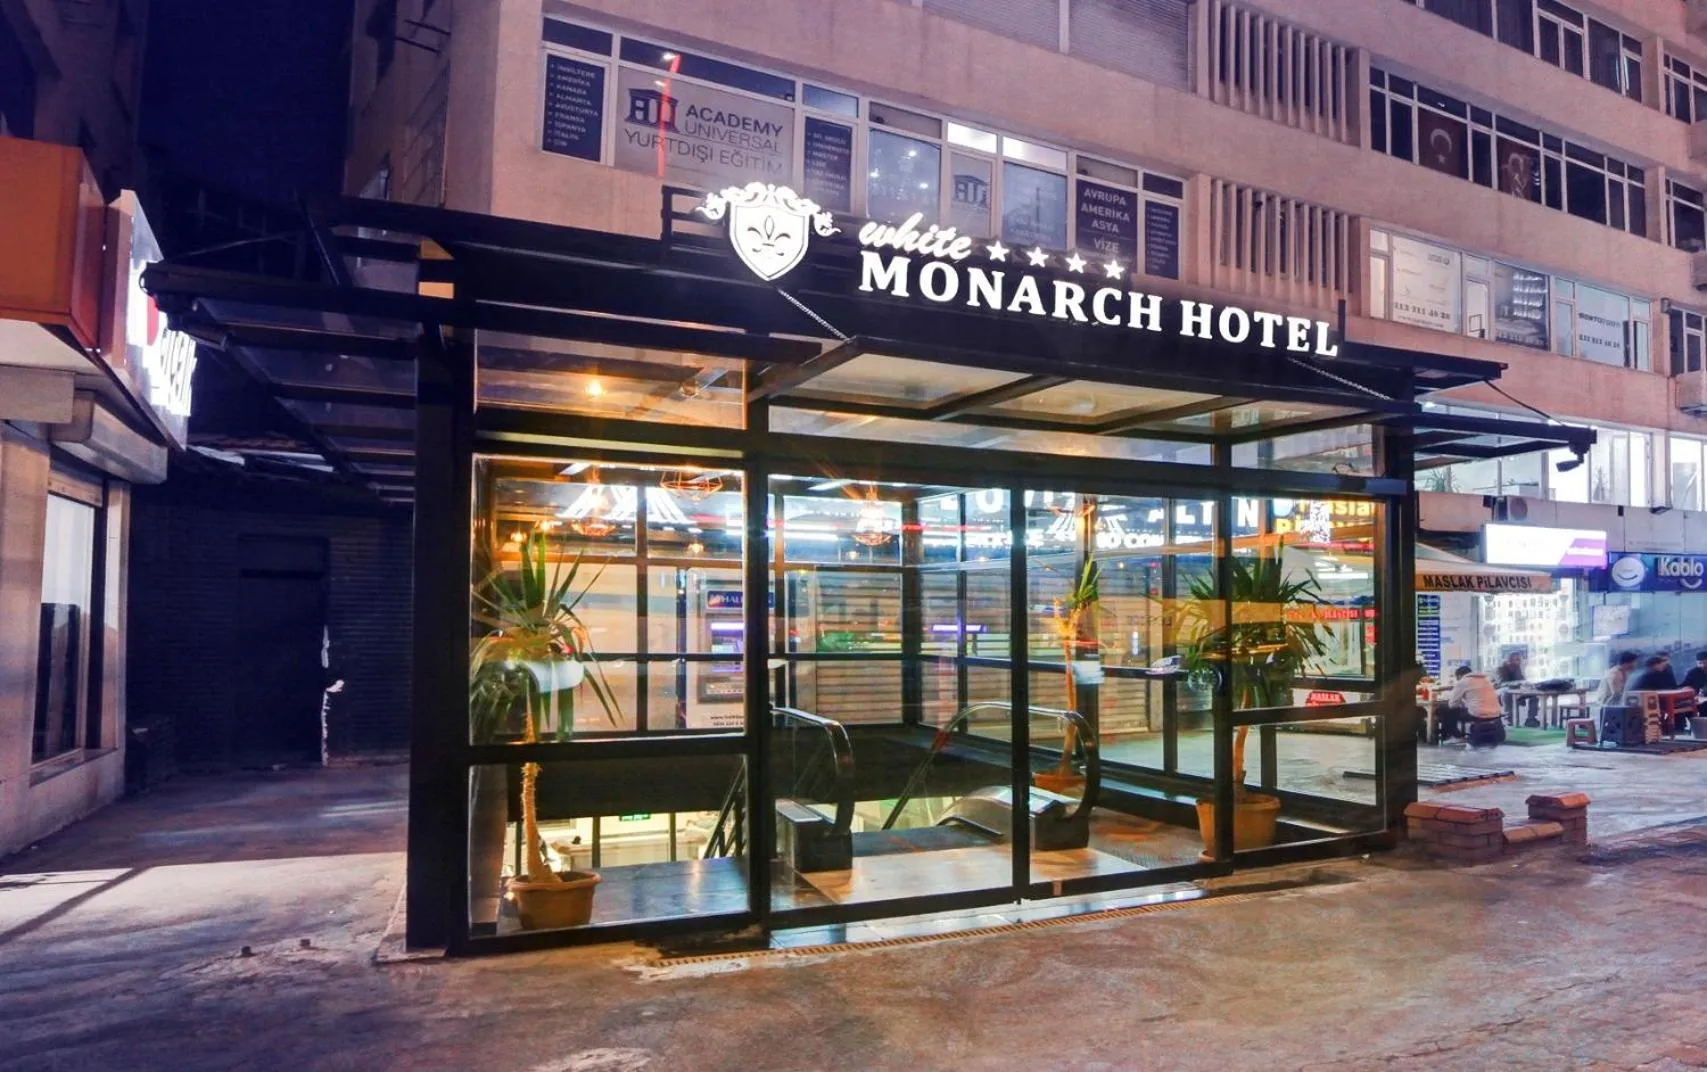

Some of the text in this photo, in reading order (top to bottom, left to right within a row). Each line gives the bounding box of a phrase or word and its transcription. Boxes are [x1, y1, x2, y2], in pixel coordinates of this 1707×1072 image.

[684, 119, 779, 153] UNIVERSAL
[685, 104, 783, 137] ACADEMY
[1083, 187, 1127, 206] AVRUPA
[858, 211, 973, 260] white
[1091, 219, 1119, 233] ASYA
[859, 250, 1339, 358] MONARCH HOTEL
[1422, 575, 1475, 589] MASLAK
